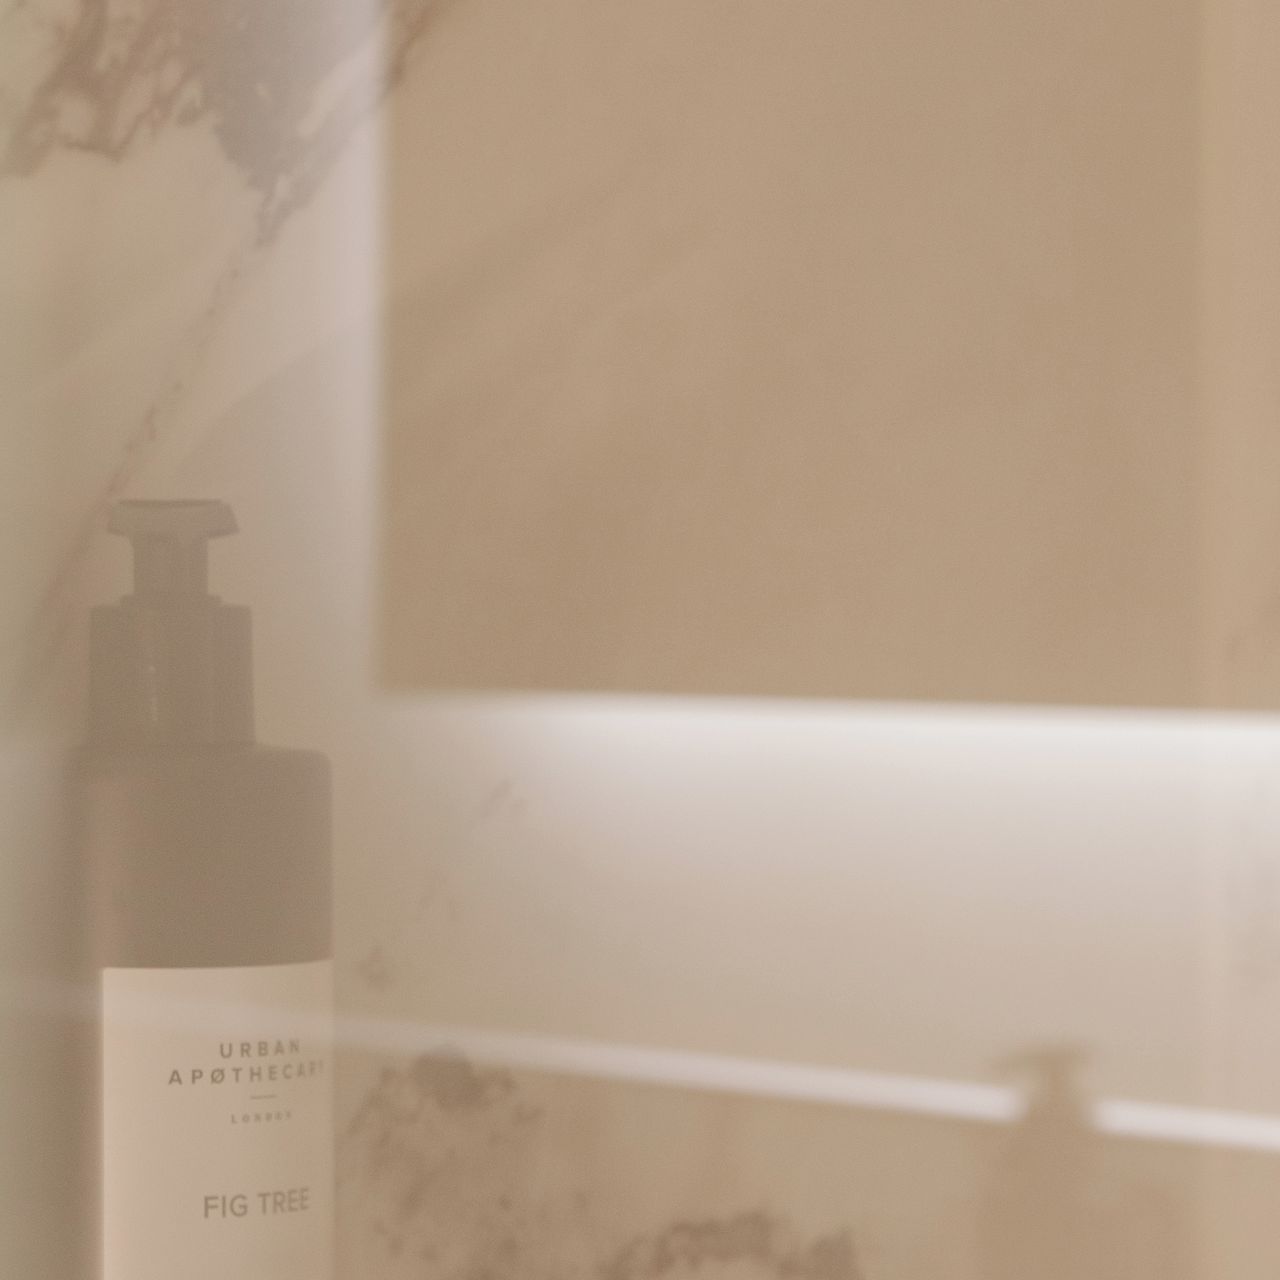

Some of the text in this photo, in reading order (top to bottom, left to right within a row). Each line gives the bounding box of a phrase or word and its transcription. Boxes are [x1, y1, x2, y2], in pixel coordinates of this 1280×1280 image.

[219, 1038, 300, 1059] URBAN
[203, 1185, 311, 1220] FIG TREE
